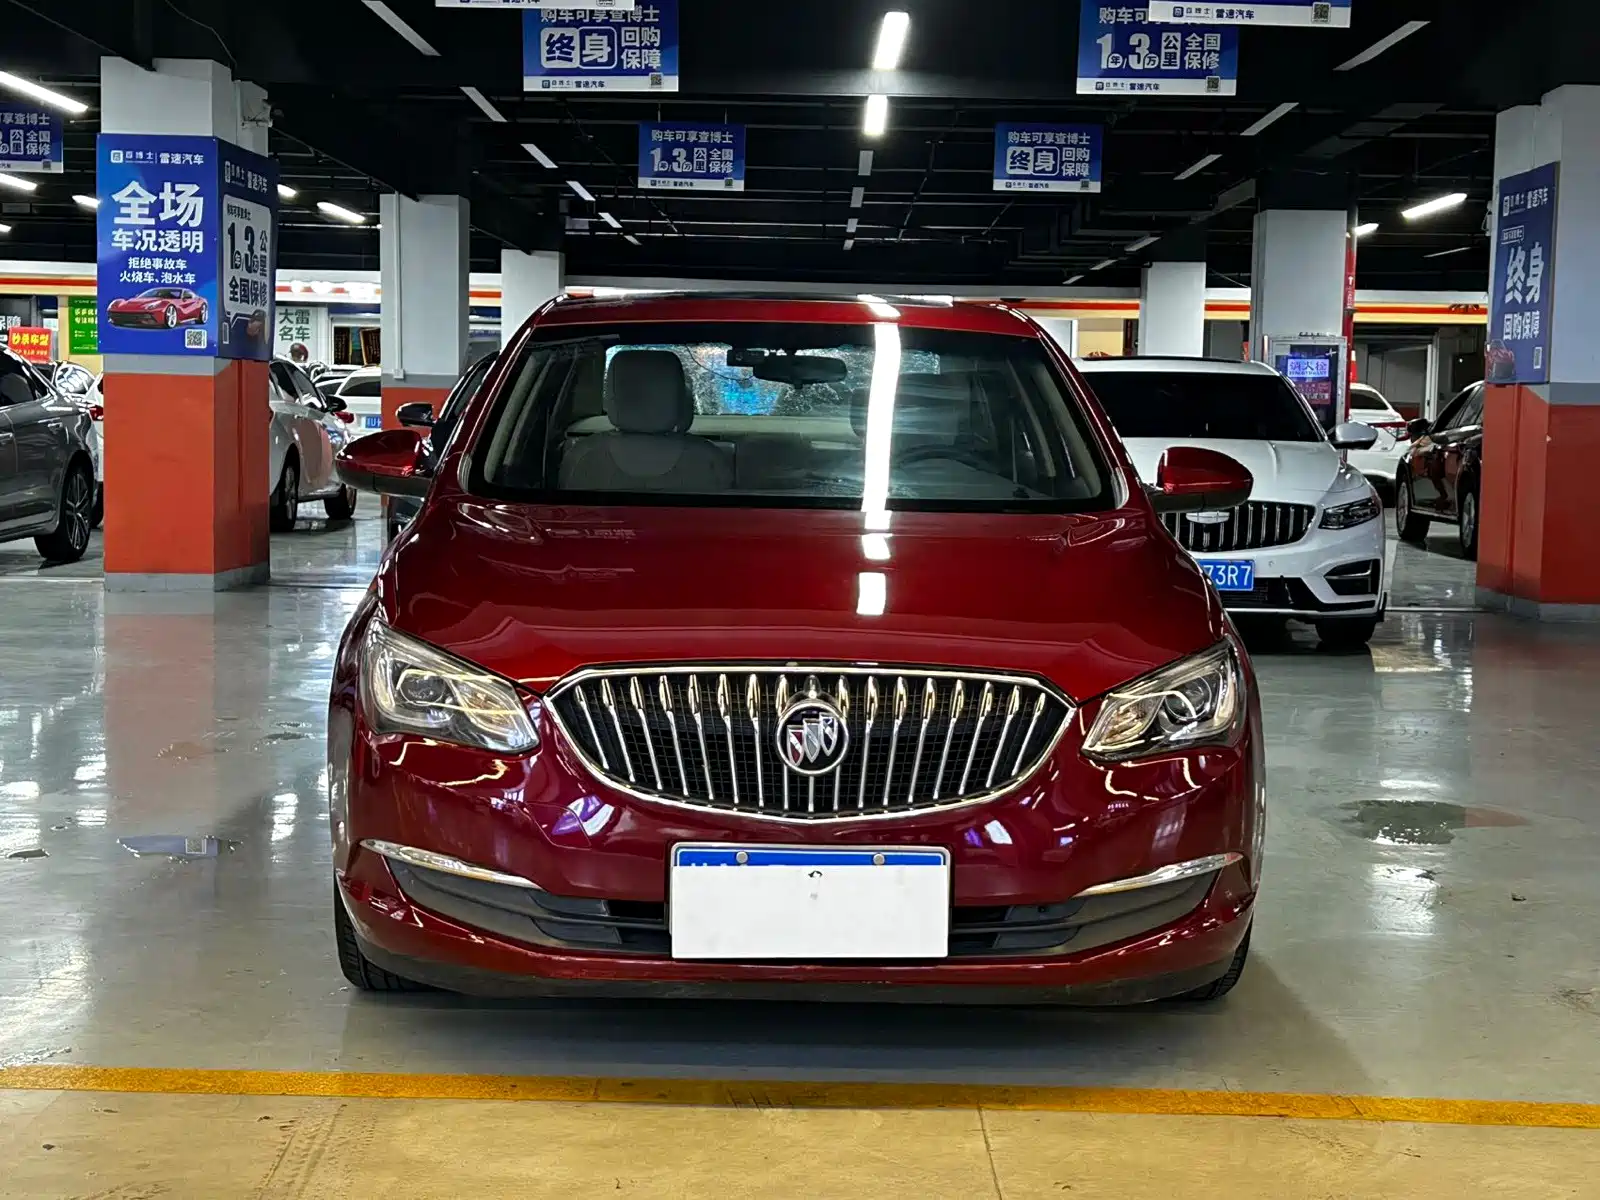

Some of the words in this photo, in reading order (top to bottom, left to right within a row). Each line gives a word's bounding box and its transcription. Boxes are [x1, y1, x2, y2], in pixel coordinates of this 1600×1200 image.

[621, 27, 660, 47] 回购
[1184, 33, 1221, 51] 全国
[544, 33, 612, 63] 终身
[621, 49, 661, 70] 保障
[1184, 52, 1220, 70] 保修
[651, 129, 733, 143] 购车可享查博士
[1007, 131, 1090, 145] 购车可享查博士
[160, 152, 204, 165] 雷速汽车
[1009, 150, 1056, 172] 终身
[1062, 147, 1090, 162] 回购
[709, 161, 733, 173] 保修
[1062, 162, 1090, 177] 保障
[111, 180, 204, 227] 全场
[111, 229, 204, 253] 车况透明
[128, 257, 187, 270] 拒绝事故车
[1504, 241, 1544, 305] 终身
[228, 276, 268, 307] 全国保修
[279, 326, 310, 342] 名车
[1503, 311, 1540, 341] 回购保障
[1206, 564, 1251, 586] 73R7
